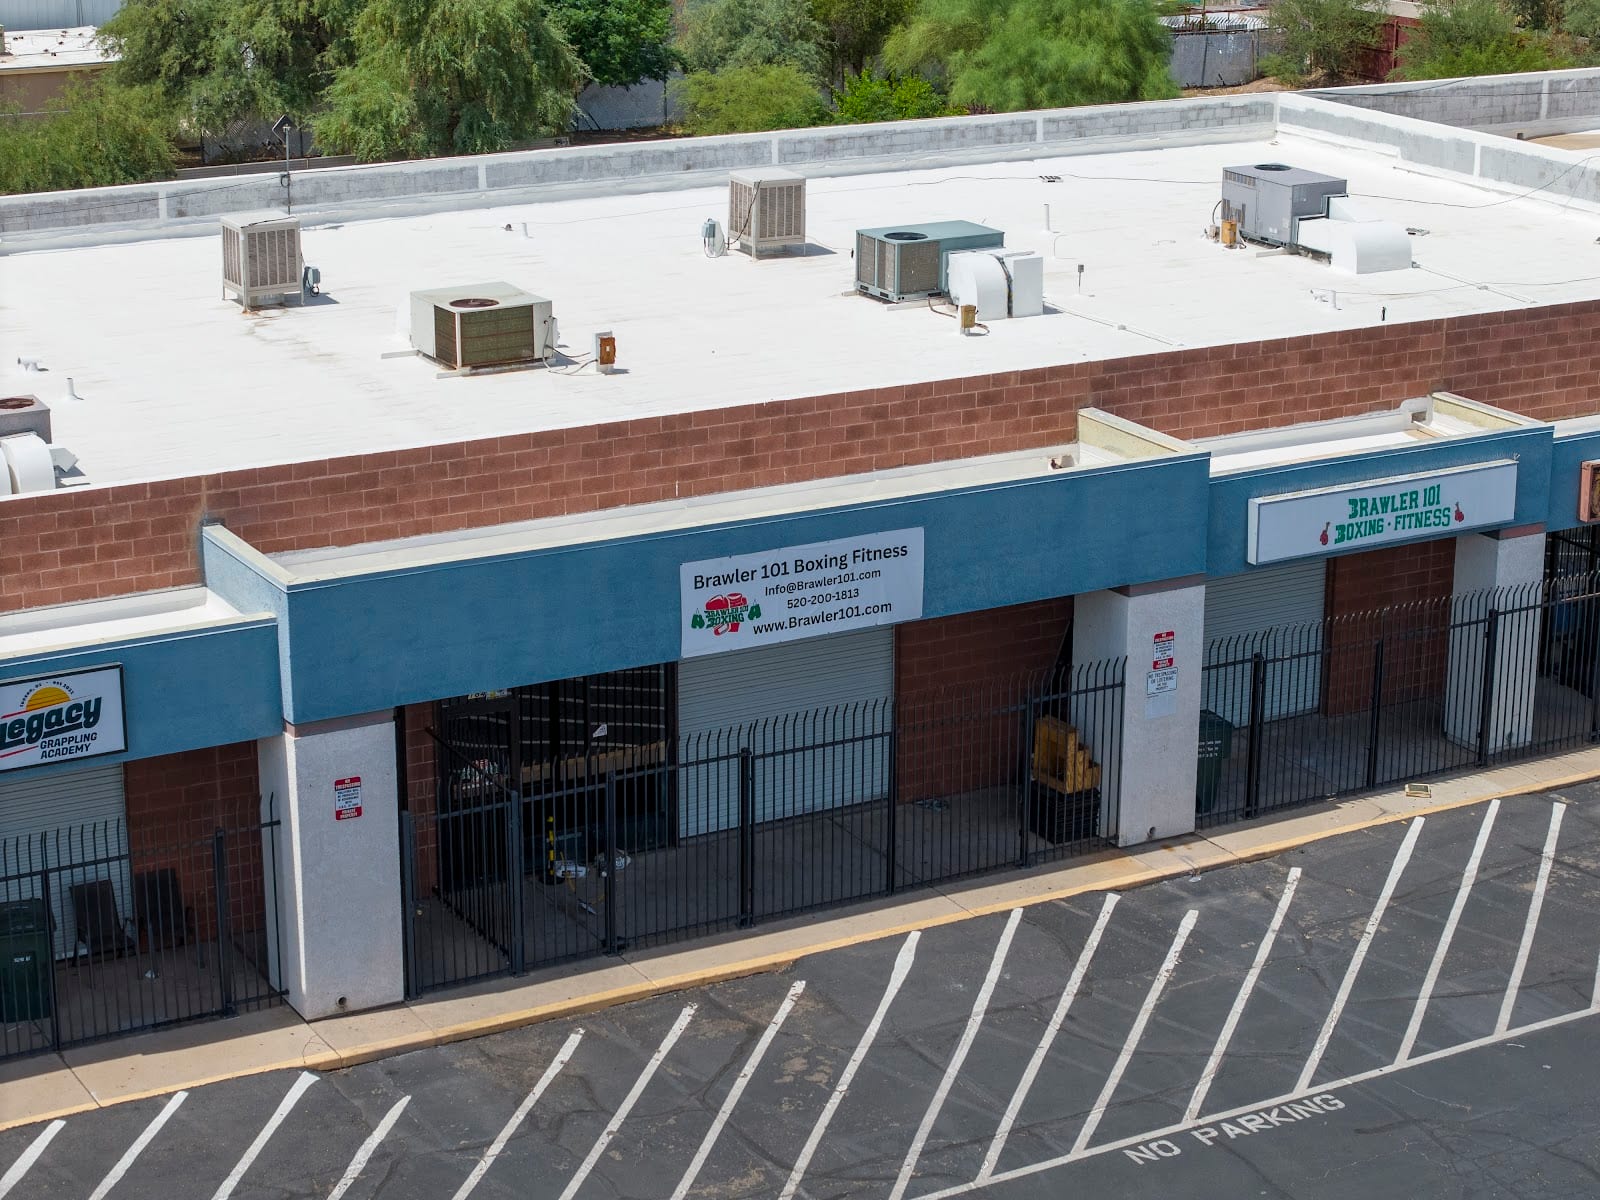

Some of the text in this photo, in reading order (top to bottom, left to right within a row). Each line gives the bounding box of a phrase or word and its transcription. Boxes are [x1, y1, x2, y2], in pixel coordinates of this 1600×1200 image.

[1348, 484, 1441, 519] BRAWLER 101
[1334, 506, 1451, 544] BOXING FITNESS
[693, 545, 908, 590] Brawler 101 Boxing Fitness
[765, 569, 881, 596] Info@Brawler101.com
[787, 588, 860, 609] 520-200-1813
[706, 612, 744, 629] BOXING
[753, 602, 892, 634] www.Brawler101.com
[40, 733, 98, 749] GRAPPLING
[40, 743, 91, 759] ACADEMY
[1122, 1094, 1346, 1165] NO PARKING
